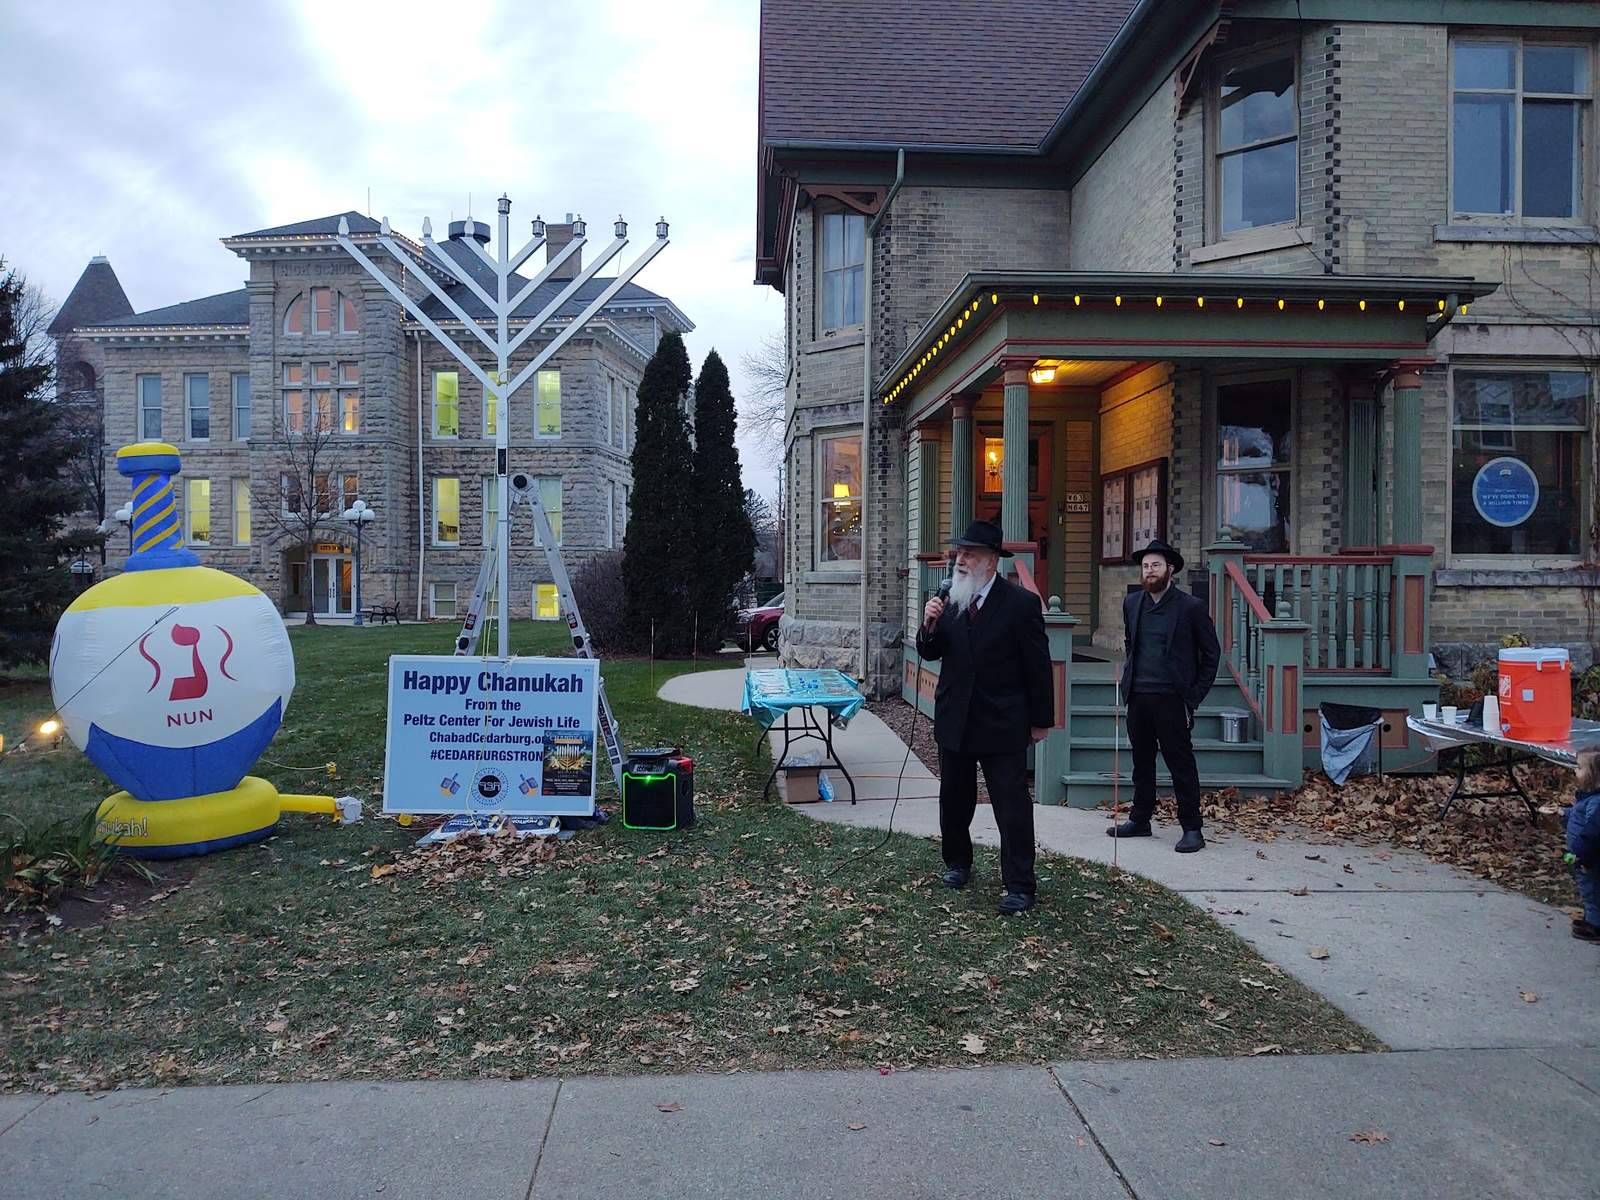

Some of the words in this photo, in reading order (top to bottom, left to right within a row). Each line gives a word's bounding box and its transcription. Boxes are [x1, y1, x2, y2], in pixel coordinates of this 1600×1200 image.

[403, 671, 471, 695] Happy
[478, 671, 583, 693] Chanukah
[465, 699, 497, 711] From
[501, 699, 521, 711] the
[167, 709, 213, 727] NUN
[404, 714, 435, 726] Peltz
[439, 715, 481, 727] Center
[485, 715, 505, 727] For
[508, 716, 552, 728] Jewish
[557, 717, 580, 728] Life
[430, 750, 543, 762] #CEDARBURGSTRON
